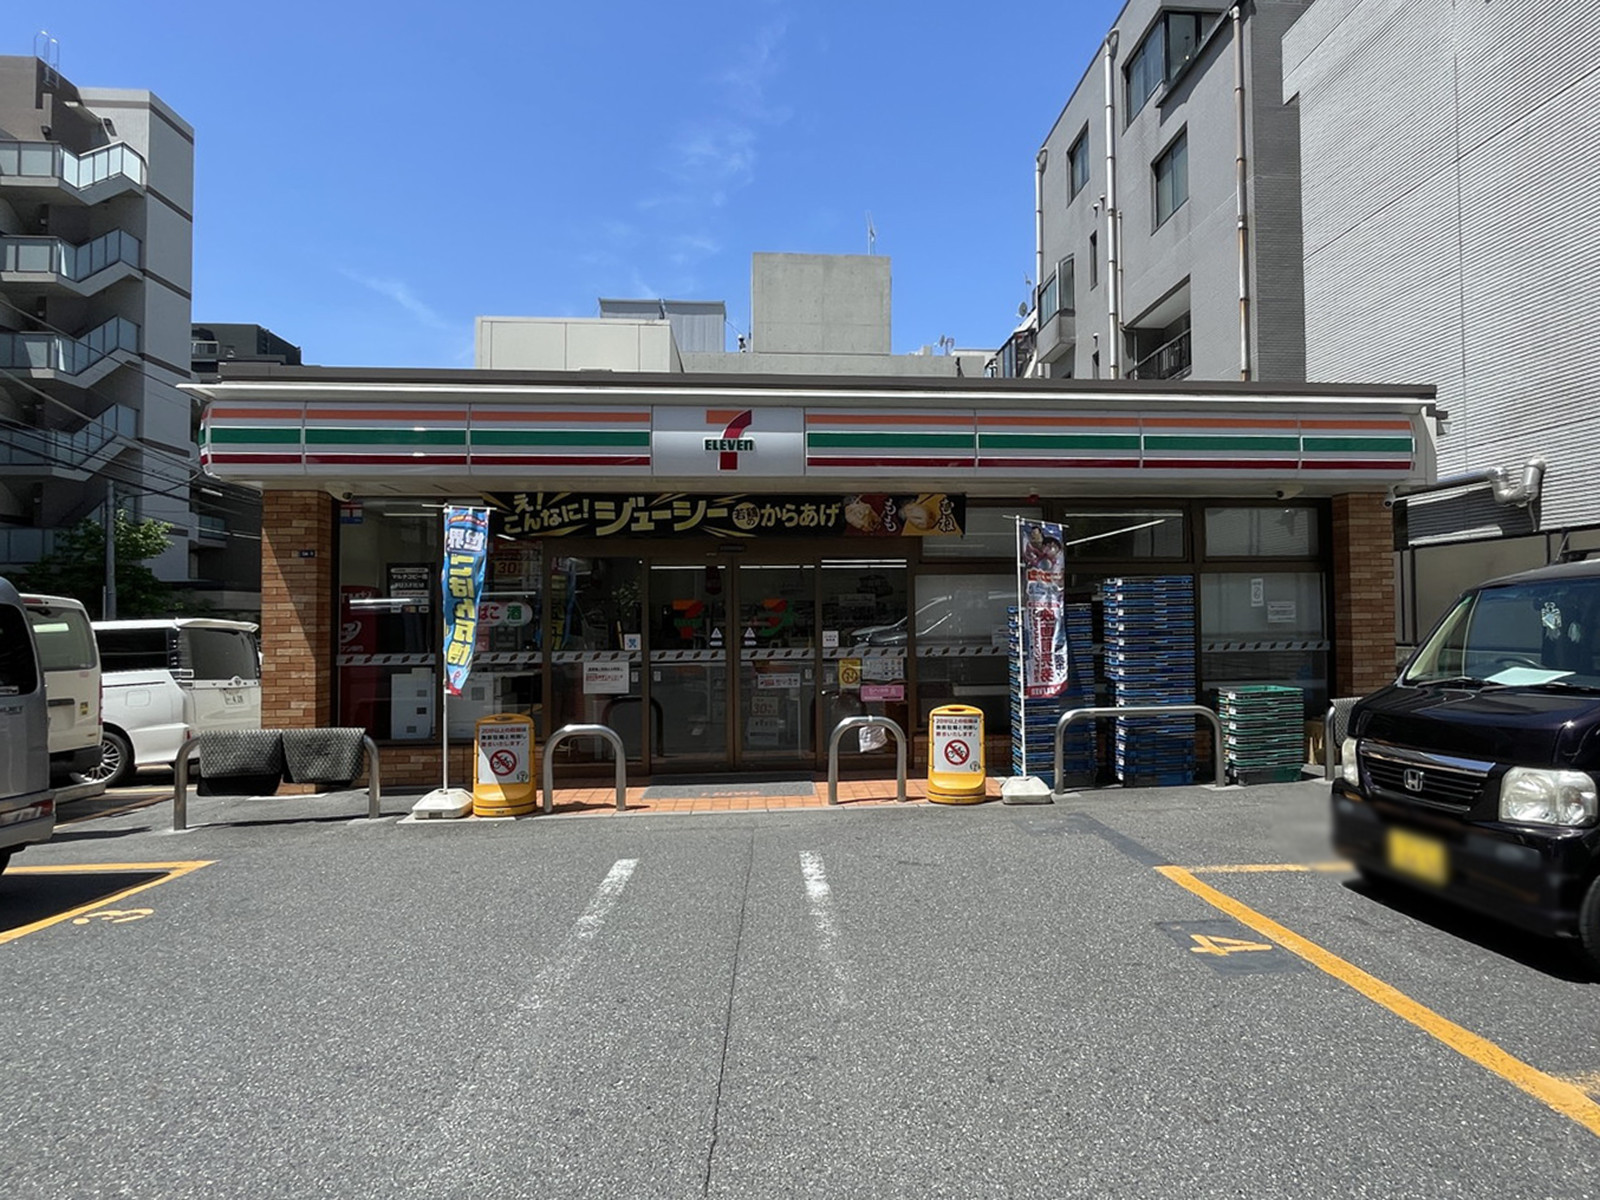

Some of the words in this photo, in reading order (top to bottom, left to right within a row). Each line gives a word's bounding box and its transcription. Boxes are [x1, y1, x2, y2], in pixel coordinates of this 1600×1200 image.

[594, 496, 728, 536] ジューシー
[760, 503, 842, 528] からあげ
[938, 498, 955, 533] むね
[1190, 934, 1272, 956] 4
